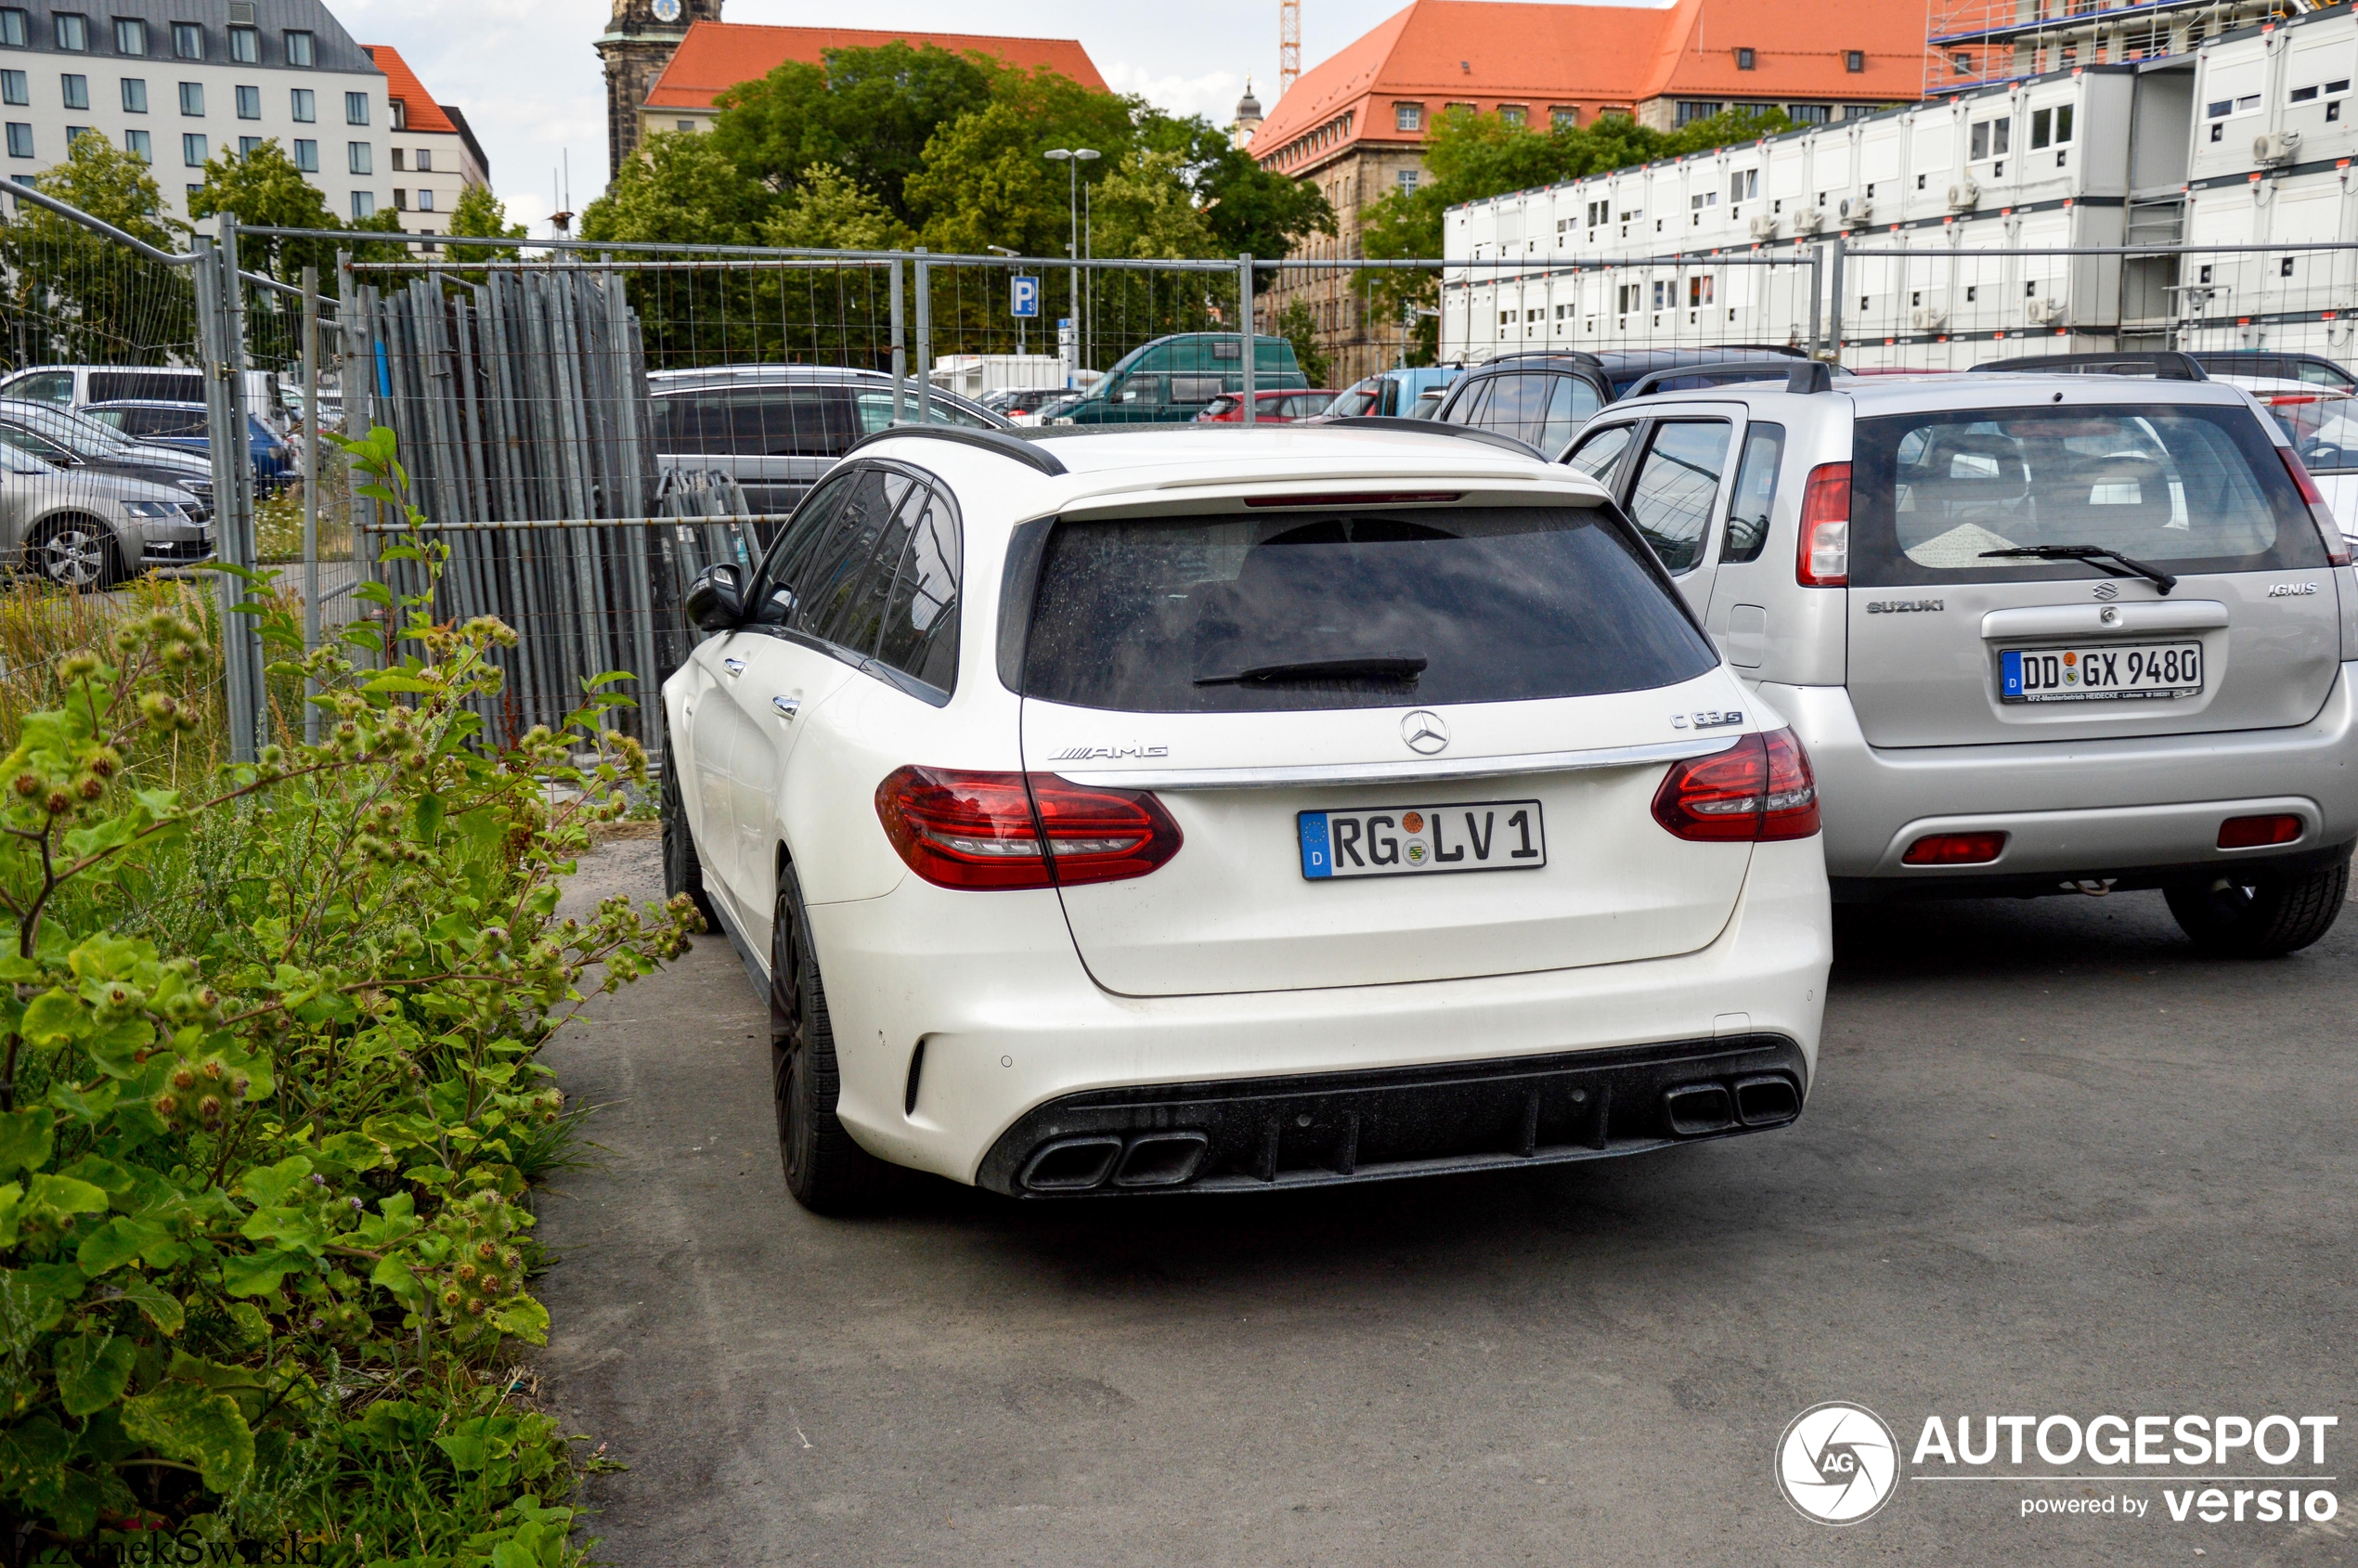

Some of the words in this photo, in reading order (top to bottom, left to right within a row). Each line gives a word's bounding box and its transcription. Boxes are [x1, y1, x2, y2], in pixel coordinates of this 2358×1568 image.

[1016, 281, 1034, 311] P
[2267, 581, 2318, 597] IGNIS
[1866, 599, 1944, 614] SUZUKI
[2023, 655, 2059, 690] DD
[2083, 653, 2118, 687] GX
[2128, 649, 2197, 685] 9480
[2009, 678, 2017, 688] D
[1669, 714, 1689, 729] C
[1085, 745, 1168, 759] AMG
[1332, 815, 1399, 868] RG
[1432, 810, 1495, 862] LV
[1508, 810, 1538, 859] 1
[1312, 851, 1323, 866] D
